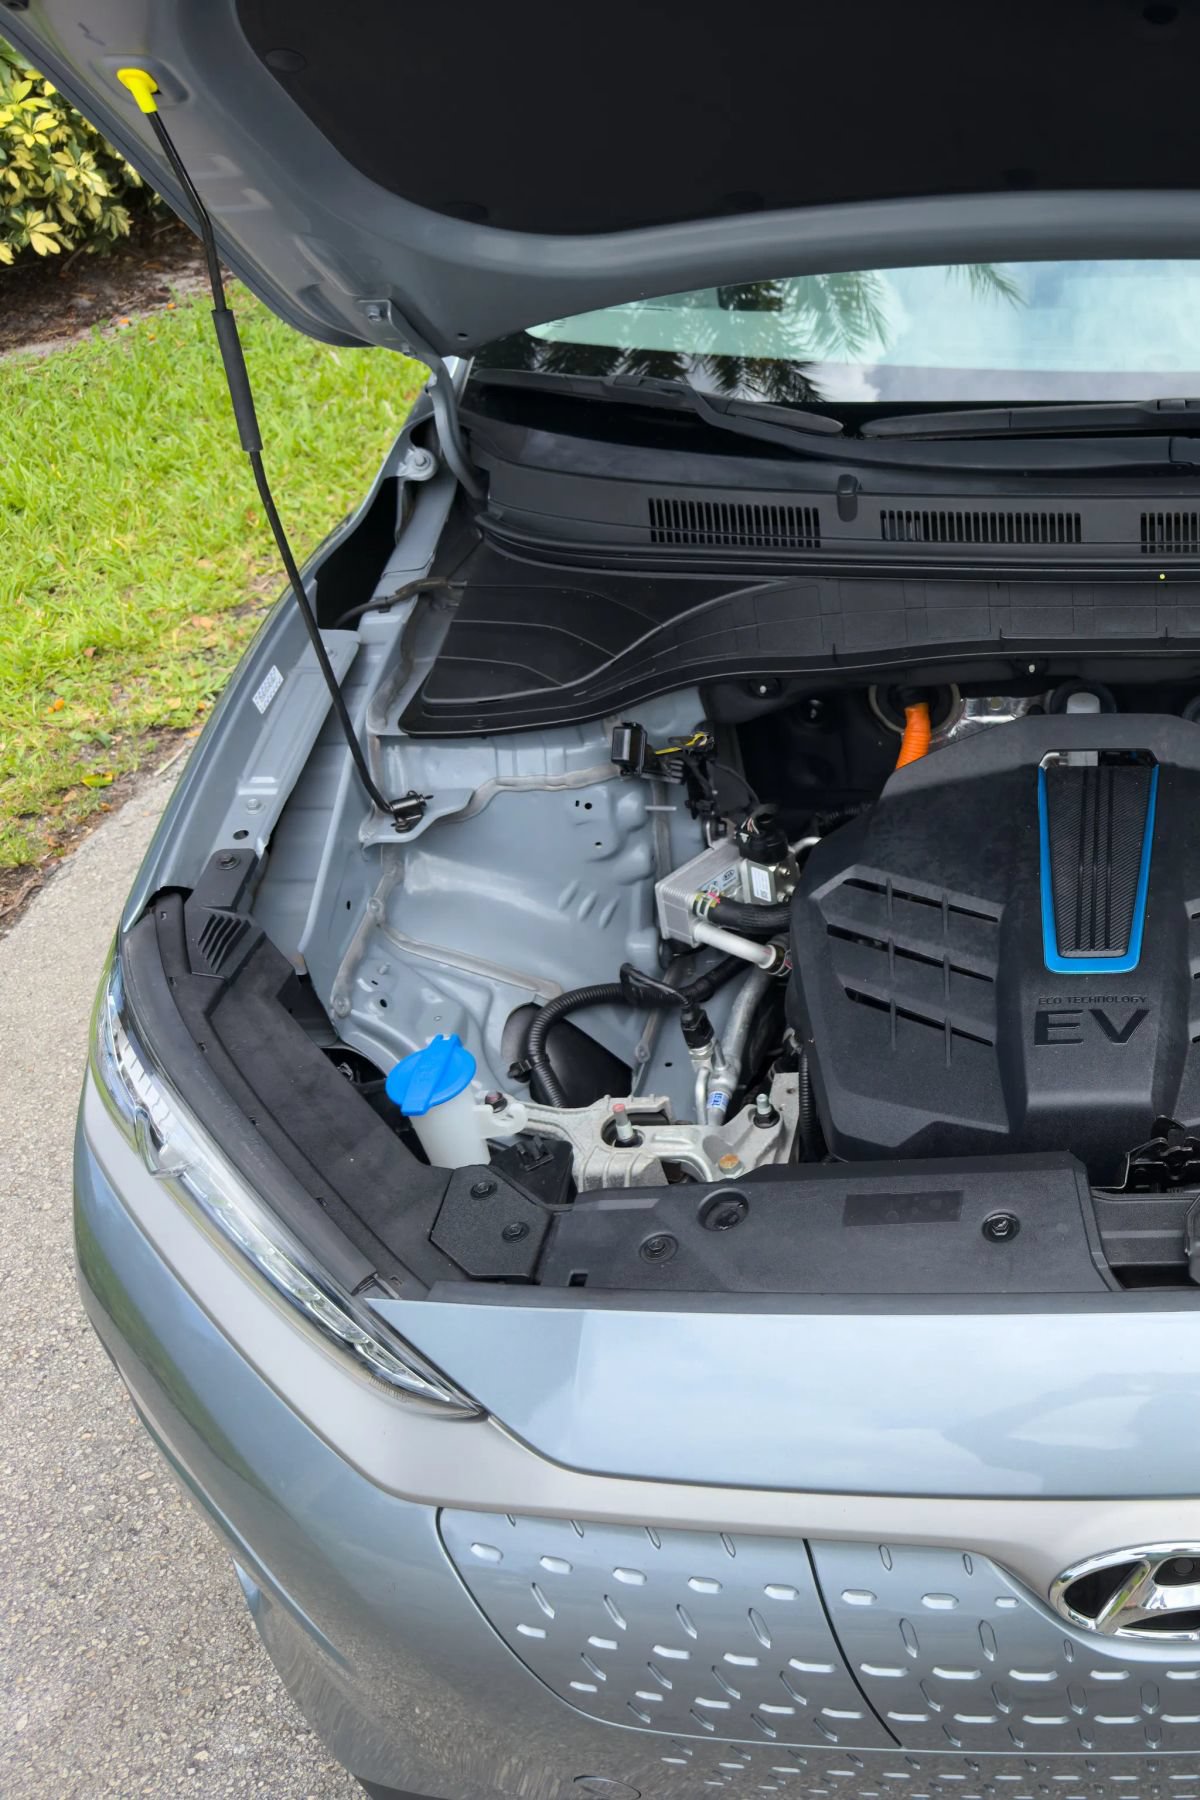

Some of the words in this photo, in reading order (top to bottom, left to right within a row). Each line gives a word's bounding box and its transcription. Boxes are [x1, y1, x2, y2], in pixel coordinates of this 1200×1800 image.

[1038, 997, 1062, 1005] ECO
[1064, 995, 1148, 1004] TECHNOLOGY
[1034, 1008, 1151, 1046] EV
